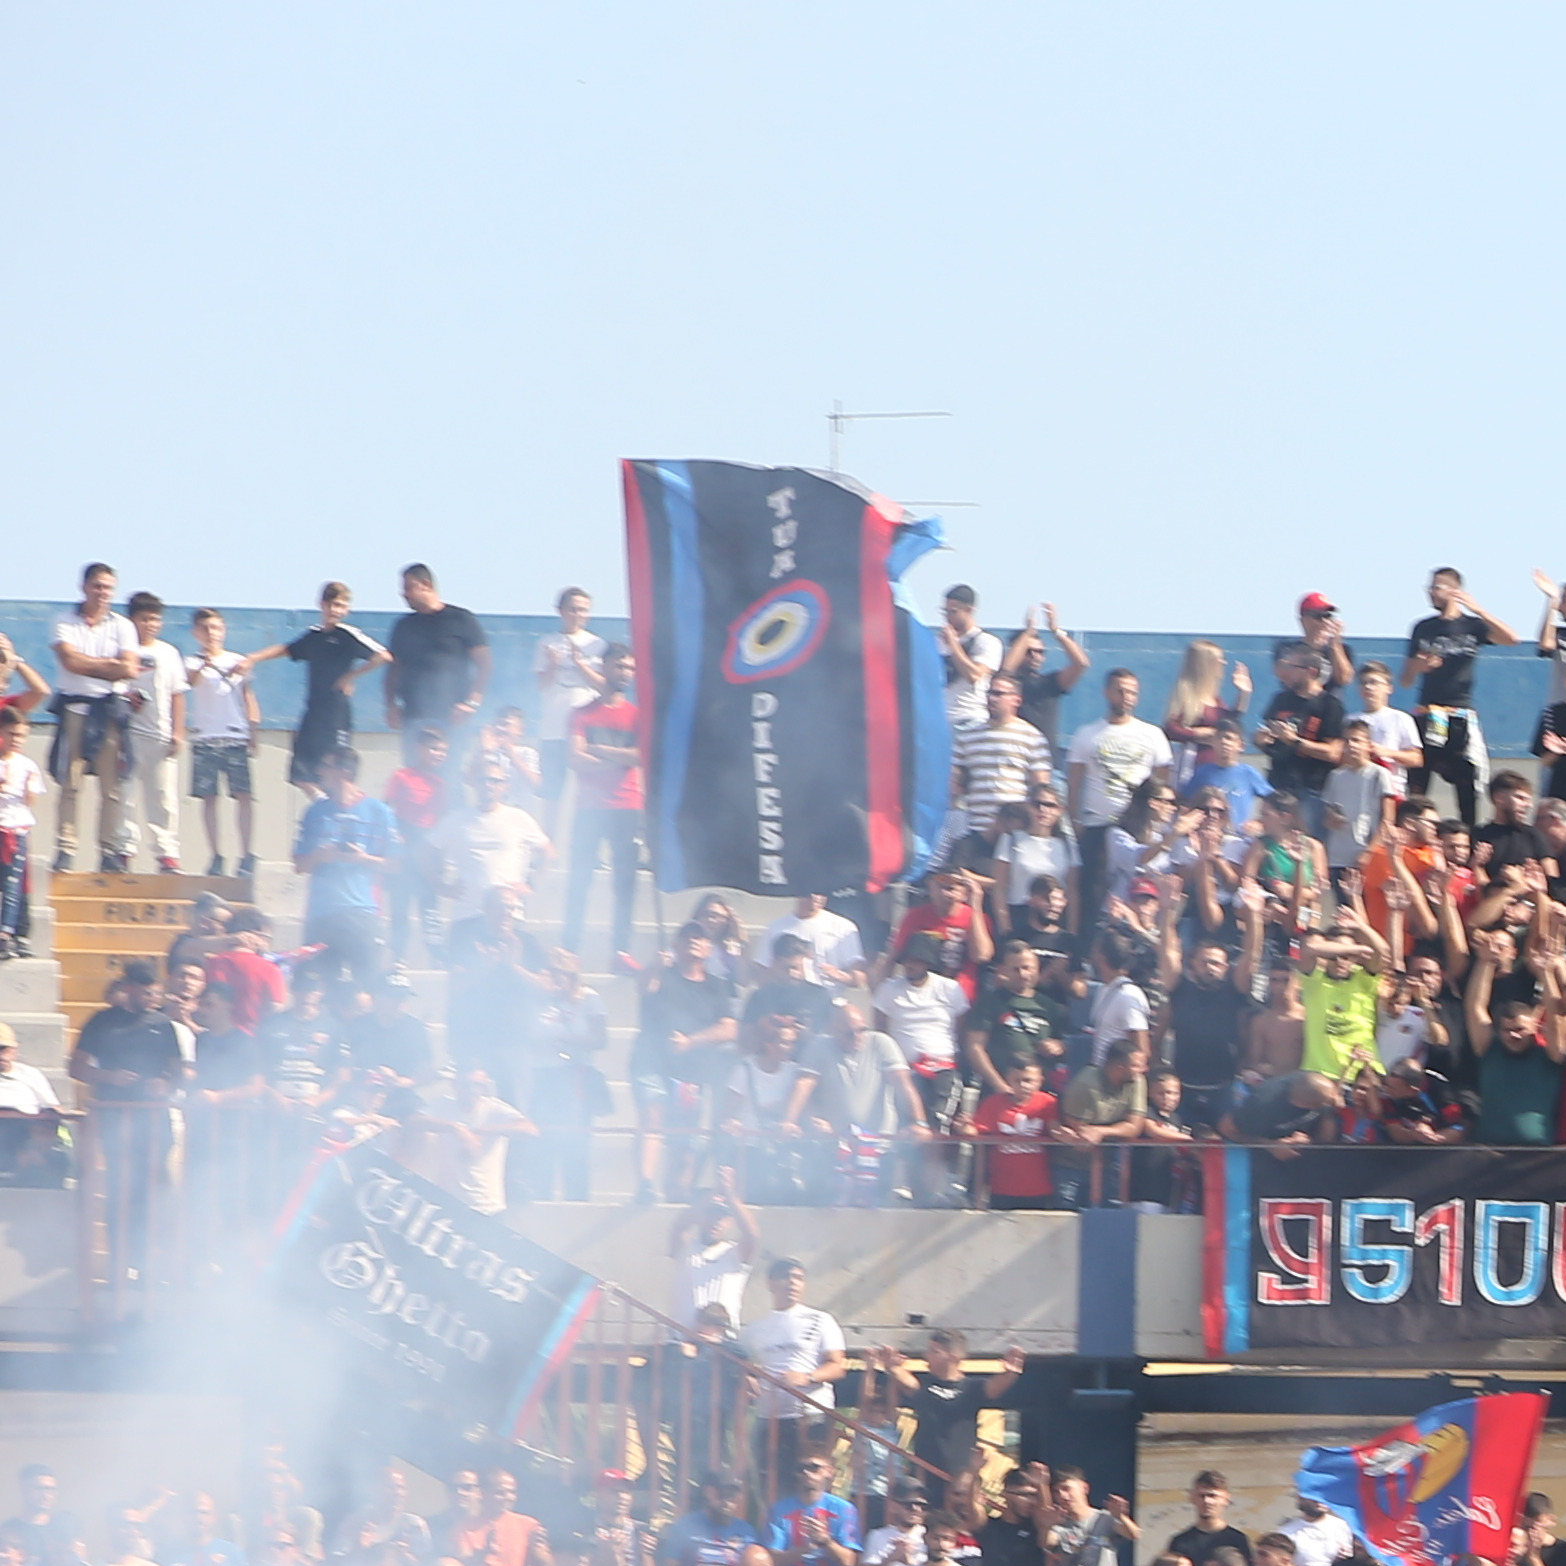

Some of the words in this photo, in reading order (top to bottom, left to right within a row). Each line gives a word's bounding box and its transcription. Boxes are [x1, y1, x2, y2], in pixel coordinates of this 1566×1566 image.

[766, 486, 797, 578] TUA
[750, 692, 787, 885] DIFESA
[355, 1166, 544, 1304] Ultras
